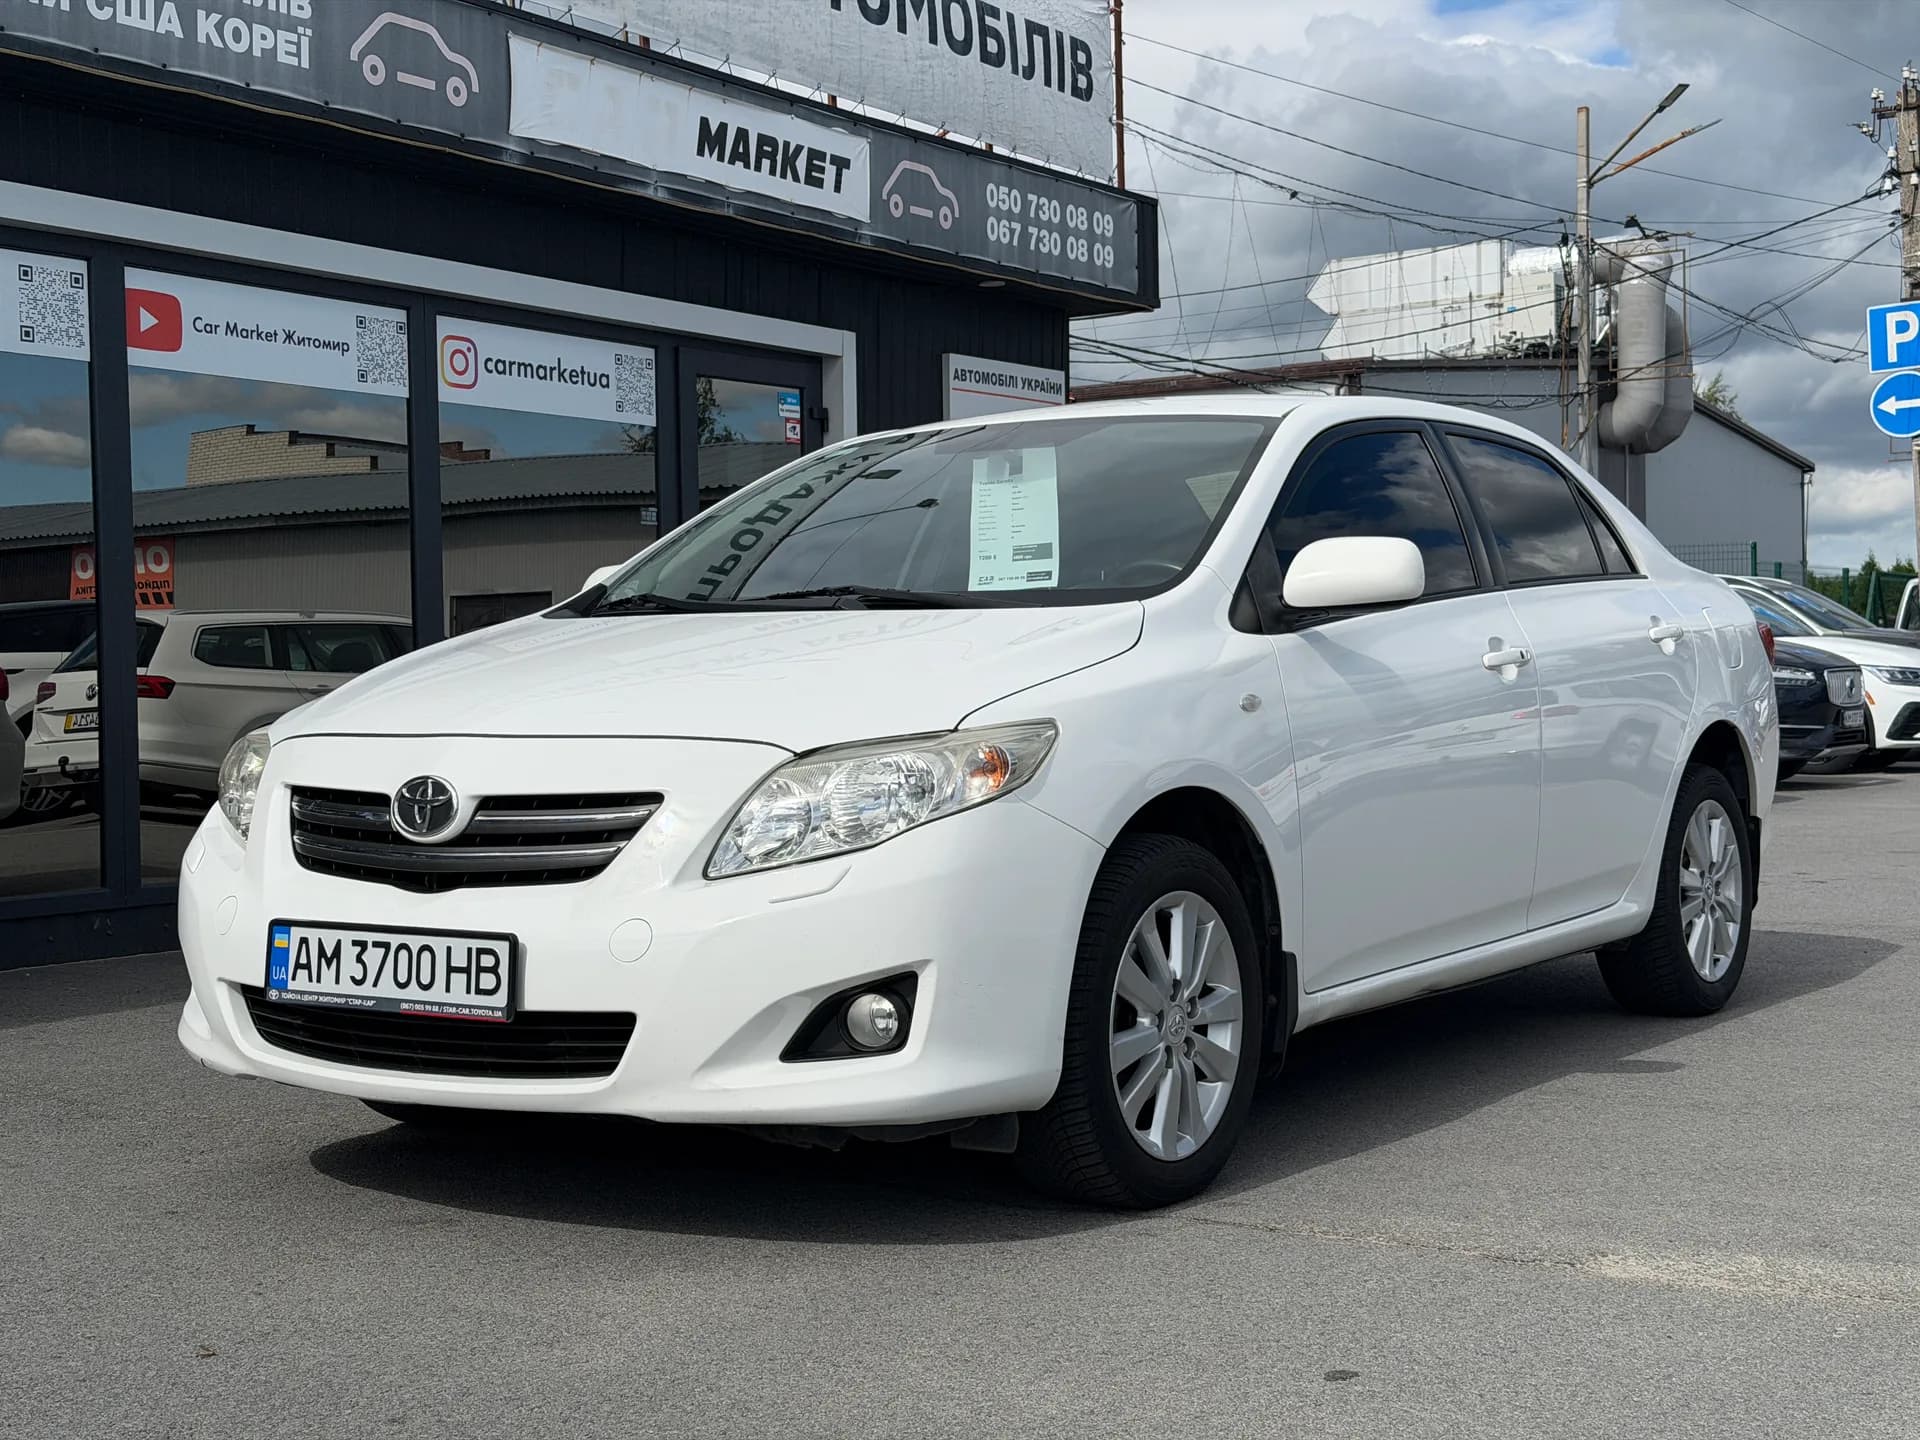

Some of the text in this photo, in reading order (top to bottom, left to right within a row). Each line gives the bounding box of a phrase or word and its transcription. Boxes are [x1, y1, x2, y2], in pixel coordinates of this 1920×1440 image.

[197, 9, 313, 69] КОРЕЇ
[696, 116, 851, 194] MARKET
[986, 183, 1114, 237] 050 730 08 09
[986, 216, 1114, 268] 067 730 08 09
[193, 317, 350, 356] Car Market Житомир
[1885, 310, 1920, 363] P
[484, 357, 610, 389] carmarketua
[953, 368, 1063, 396] АВТОМОБІЛІ УКРАЇНИ
[272, 966, 287, 980] UA
[291, 937, 502, 996] AM 3700 HB
